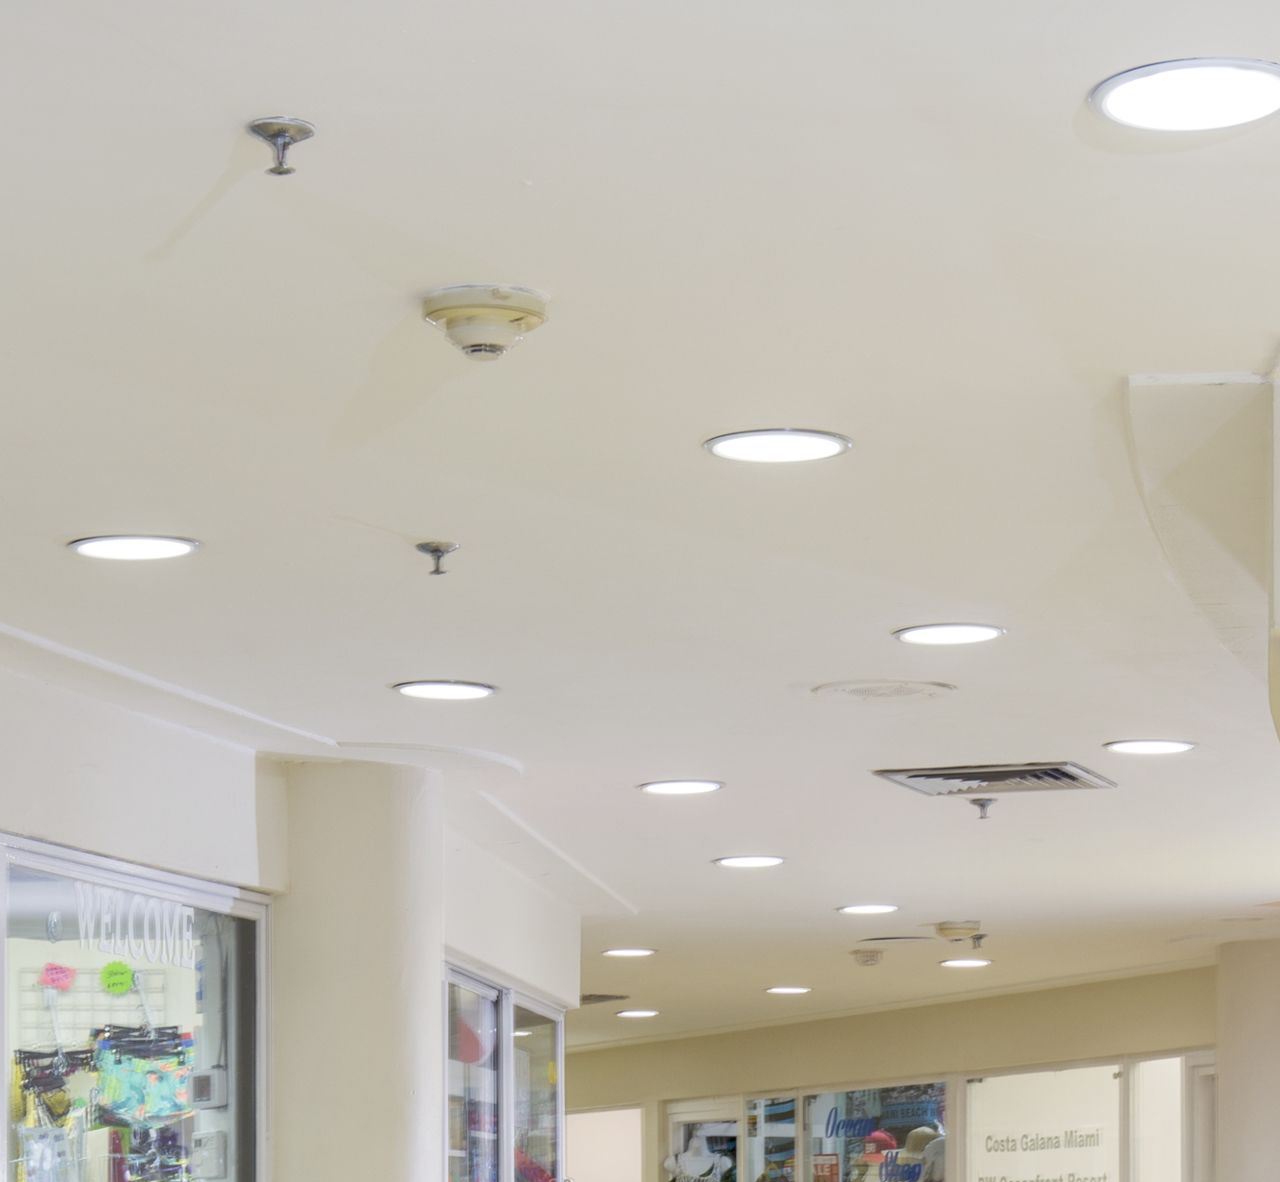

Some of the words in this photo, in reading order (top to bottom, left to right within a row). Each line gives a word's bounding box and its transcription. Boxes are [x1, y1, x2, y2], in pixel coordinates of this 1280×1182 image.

[74, 881, 196, 970] WELCOME
[984, 1133, 1018, 1153] Costa
[1020, 1132, 1061, 1152] Galana
[1063, 1128, 1100, 1149] Miami
